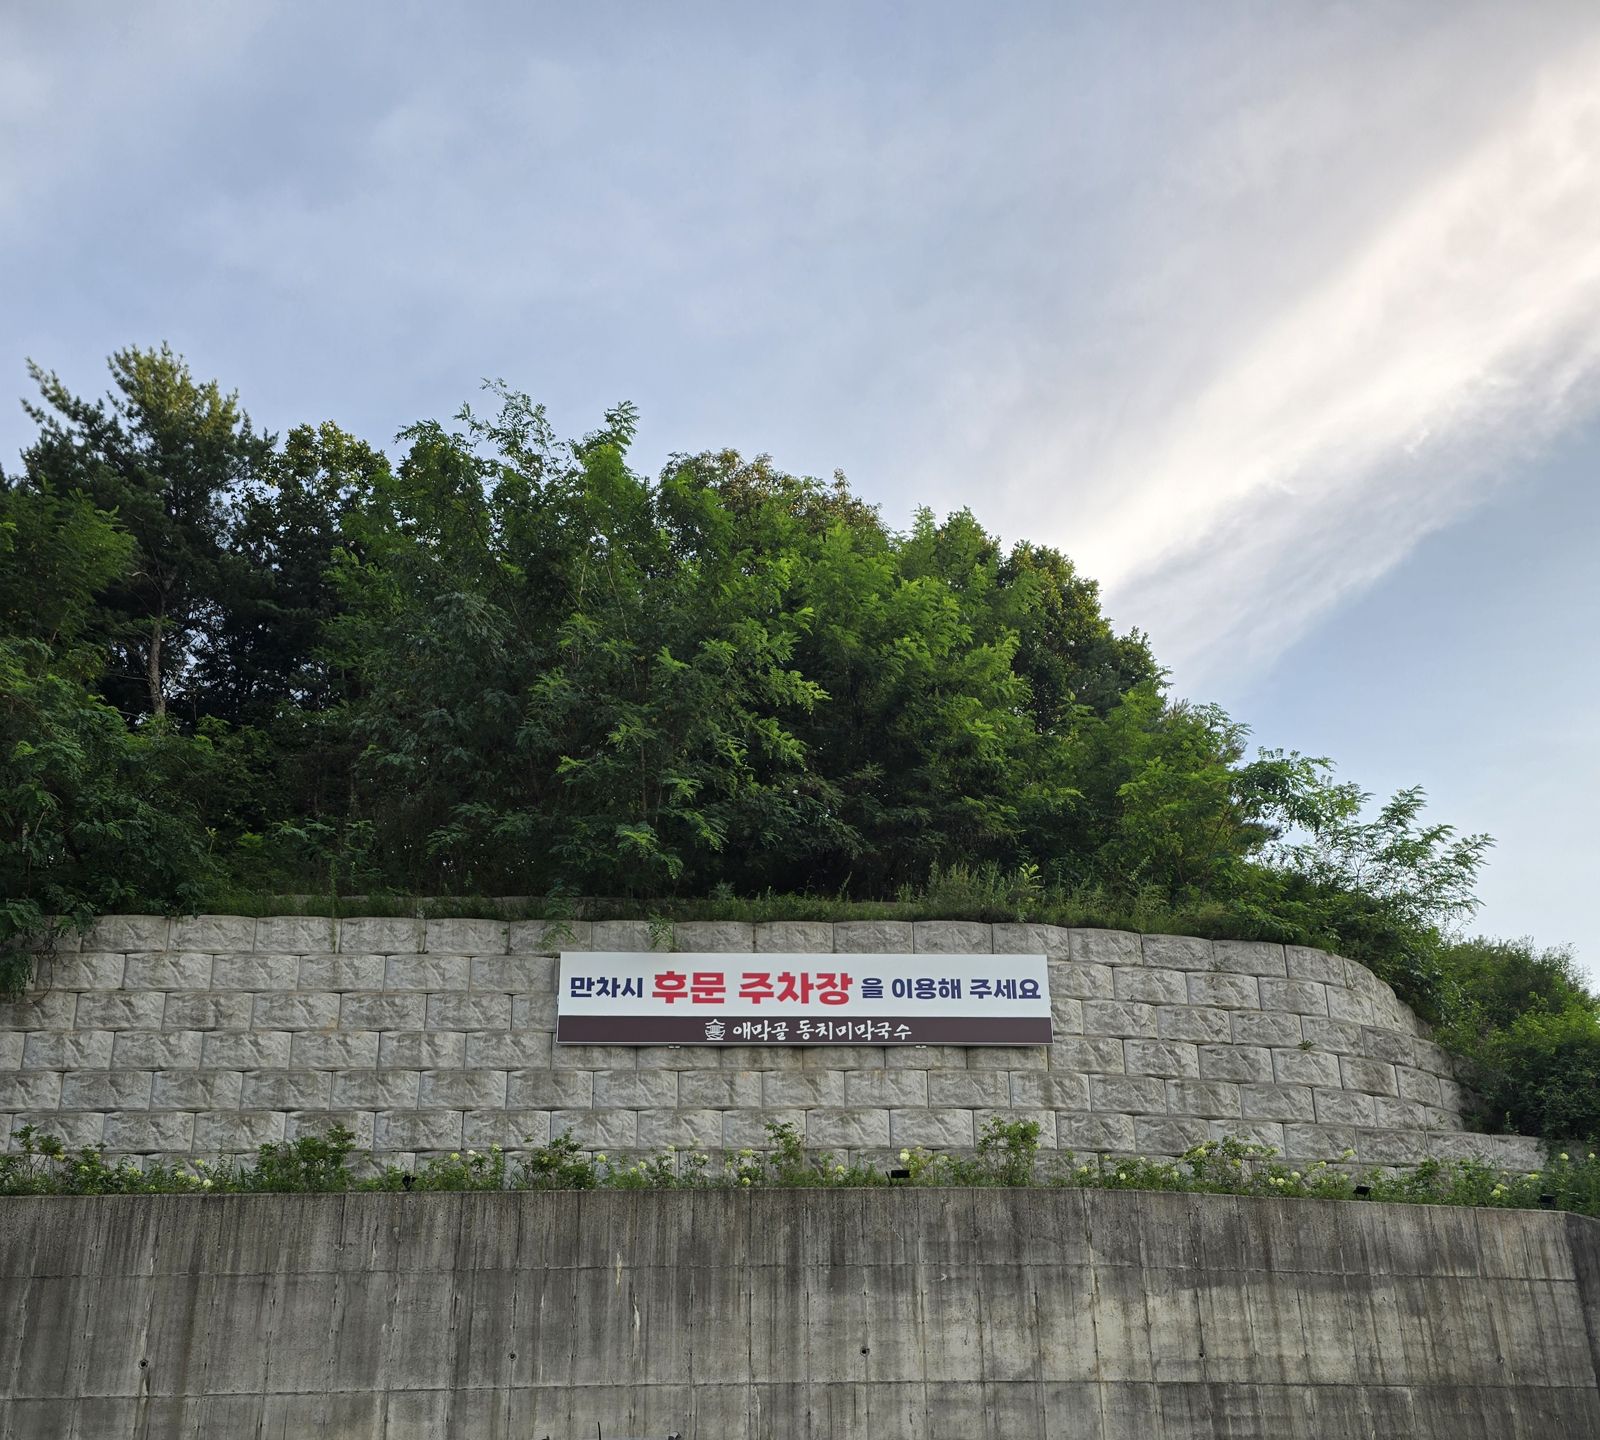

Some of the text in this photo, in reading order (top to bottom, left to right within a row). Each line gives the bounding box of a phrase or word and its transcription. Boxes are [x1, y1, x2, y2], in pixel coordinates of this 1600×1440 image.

[570, 970, 1042, 1006] 만차시 후문 주차장 을 이용해 주세요
[732, 1019, 912, 1041] 애막골 동치미막국수
